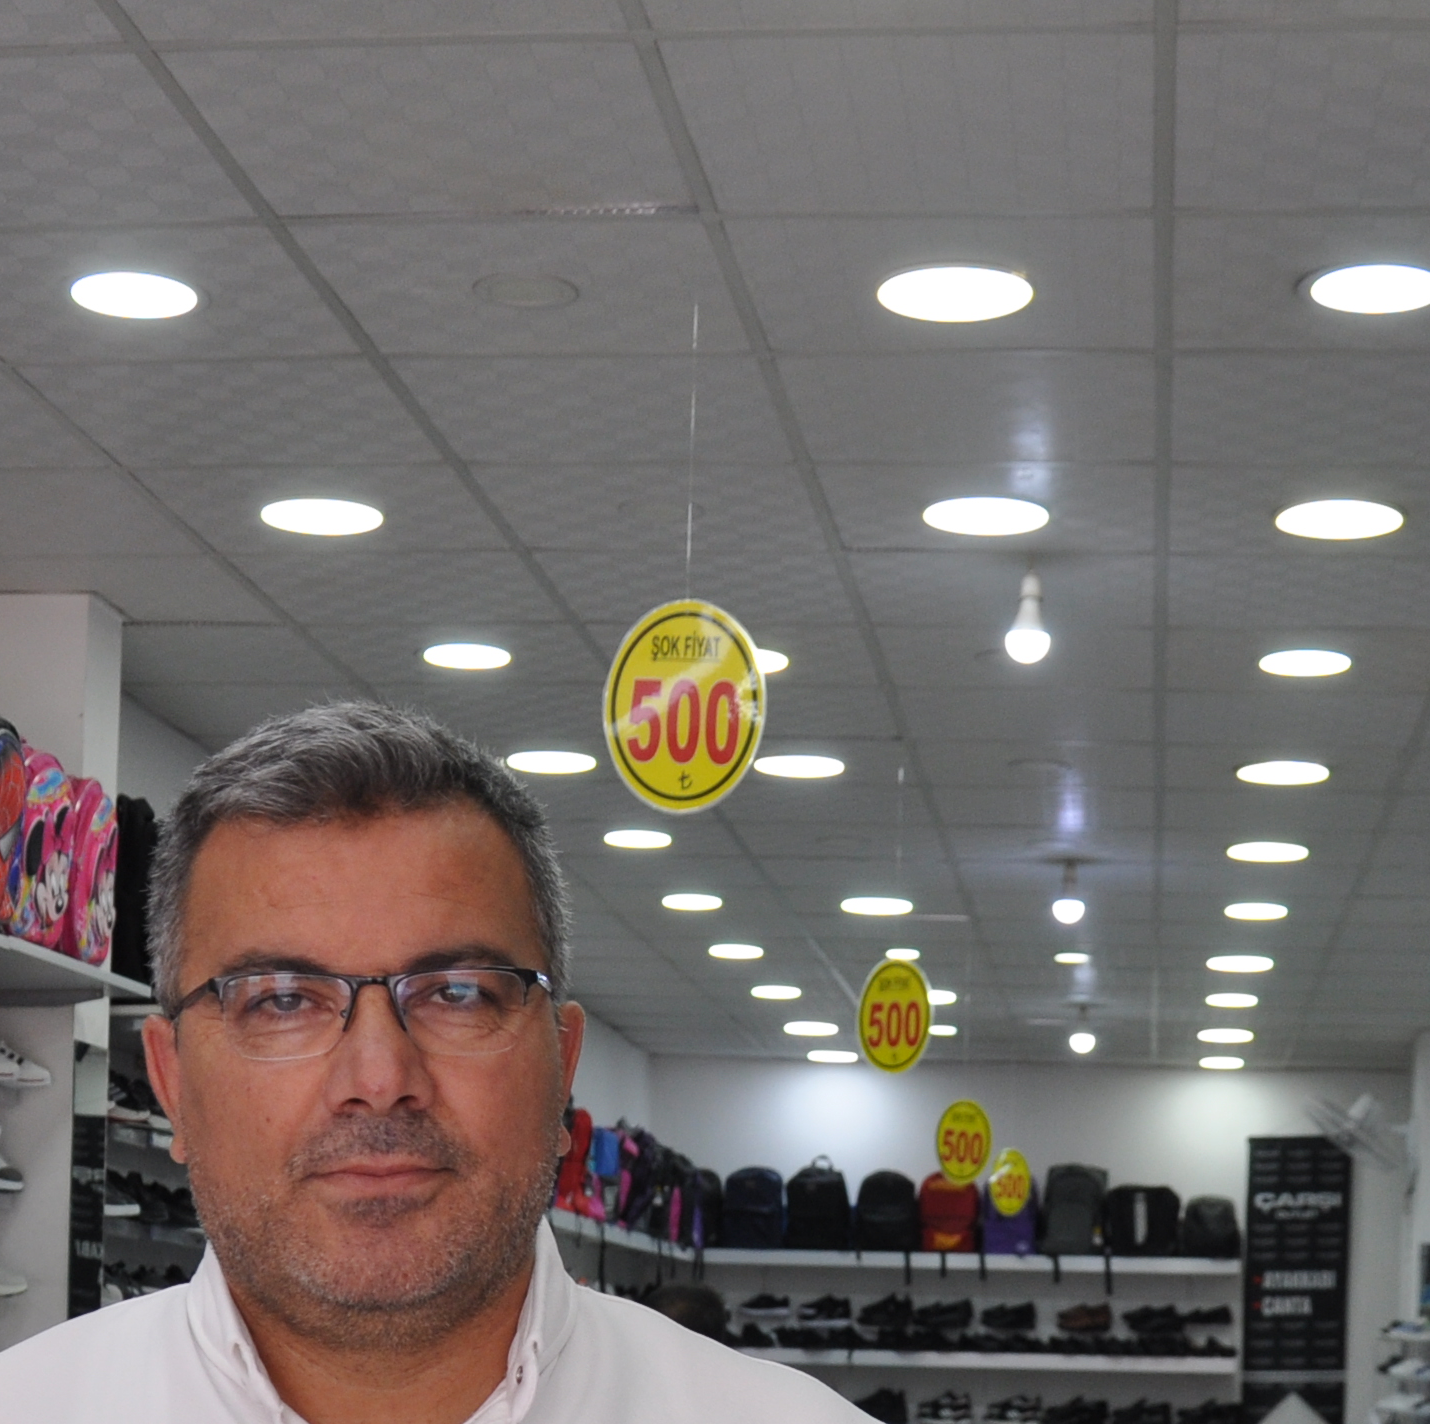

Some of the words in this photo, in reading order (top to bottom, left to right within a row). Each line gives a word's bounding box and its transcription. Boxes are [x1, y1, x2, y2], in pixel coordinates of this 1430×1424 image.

[651, 635, 680, 662] ŞOK
[683, 630, 722, 659] FİYAT
[627, 678, 741, 766] 500
[868, 1000, 921, 1048] 500
[941, 1128, 985, 1165] 500
